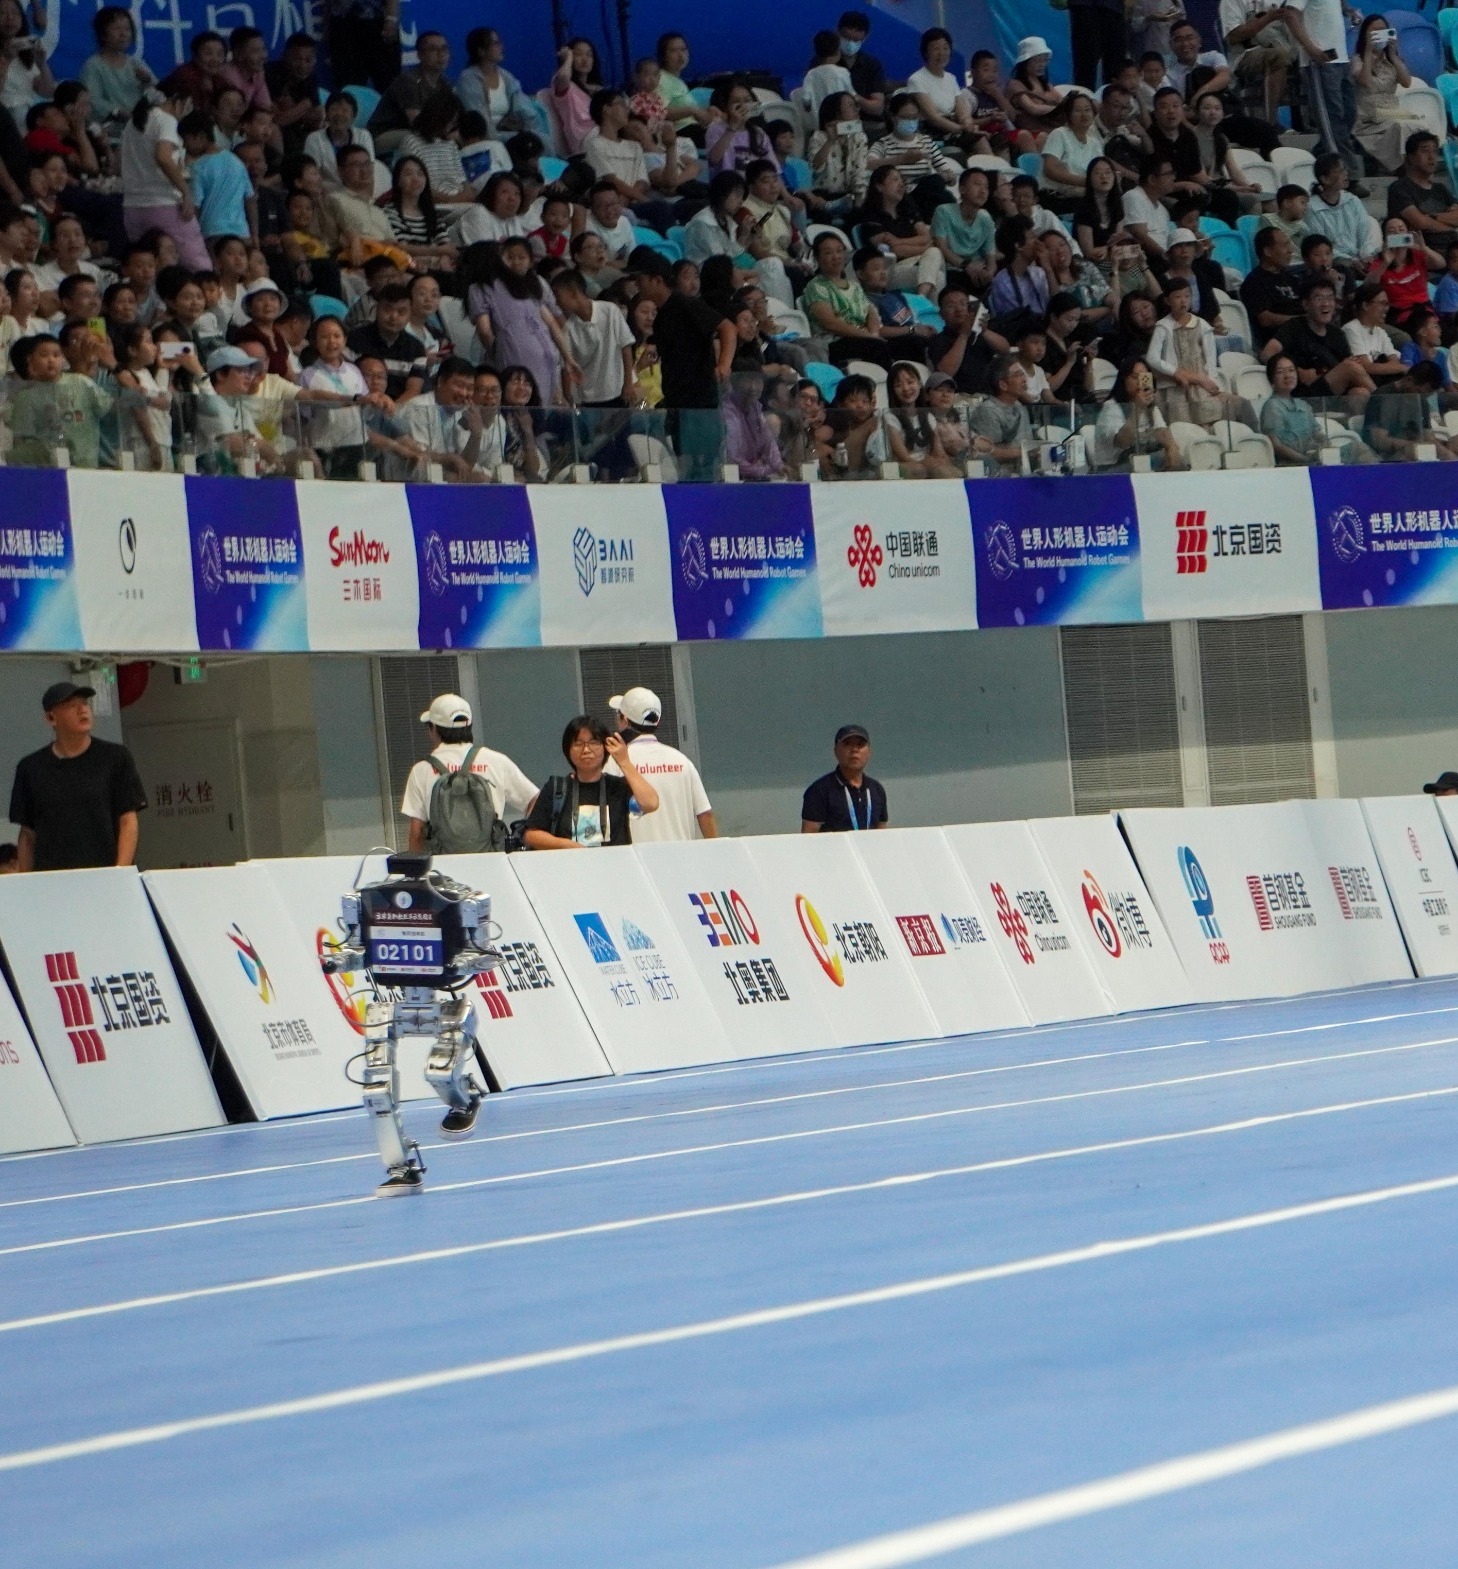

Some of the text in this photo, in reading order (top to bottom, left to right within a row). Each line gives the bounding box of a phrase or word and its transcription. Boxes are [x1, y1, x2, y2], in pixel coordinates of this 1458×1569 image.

[224, 536, 297, 563] 世界人形机器人运动会
[599, 539, 634, 561] BAAI
[710, 536, 805, 560] 世界人形机器人运动会
[886, 530, 940, 558] 中国联通
[1021, 524, 1129, 550] 世界人形机器人运动会
[1213, 523, 1282, 557] 北京国资
[1372, 541, 1385, 552] The
[1386, 540, 1407, 551] World
[1408, 538, 1443, 550] Humanoid
[449, 539, 530, 565] 世界人形机器人运动会
[1023, 553, 1130, 569] The World Humanoid Robot Games
[888, 563, 940, 578] China unicom
[342, 577, 382, 601] 三木国际
[156, 781, 214, 805] 消火栓
[1263, 871, 1312, 912] 首钢基金
[1016, 890, 1059, 925] 中国联通
[377, 944, 435, 962] 02101
[832, 920, 889, 964] 北京朝阳
[90, 970, 171, 1032] 北京国资
